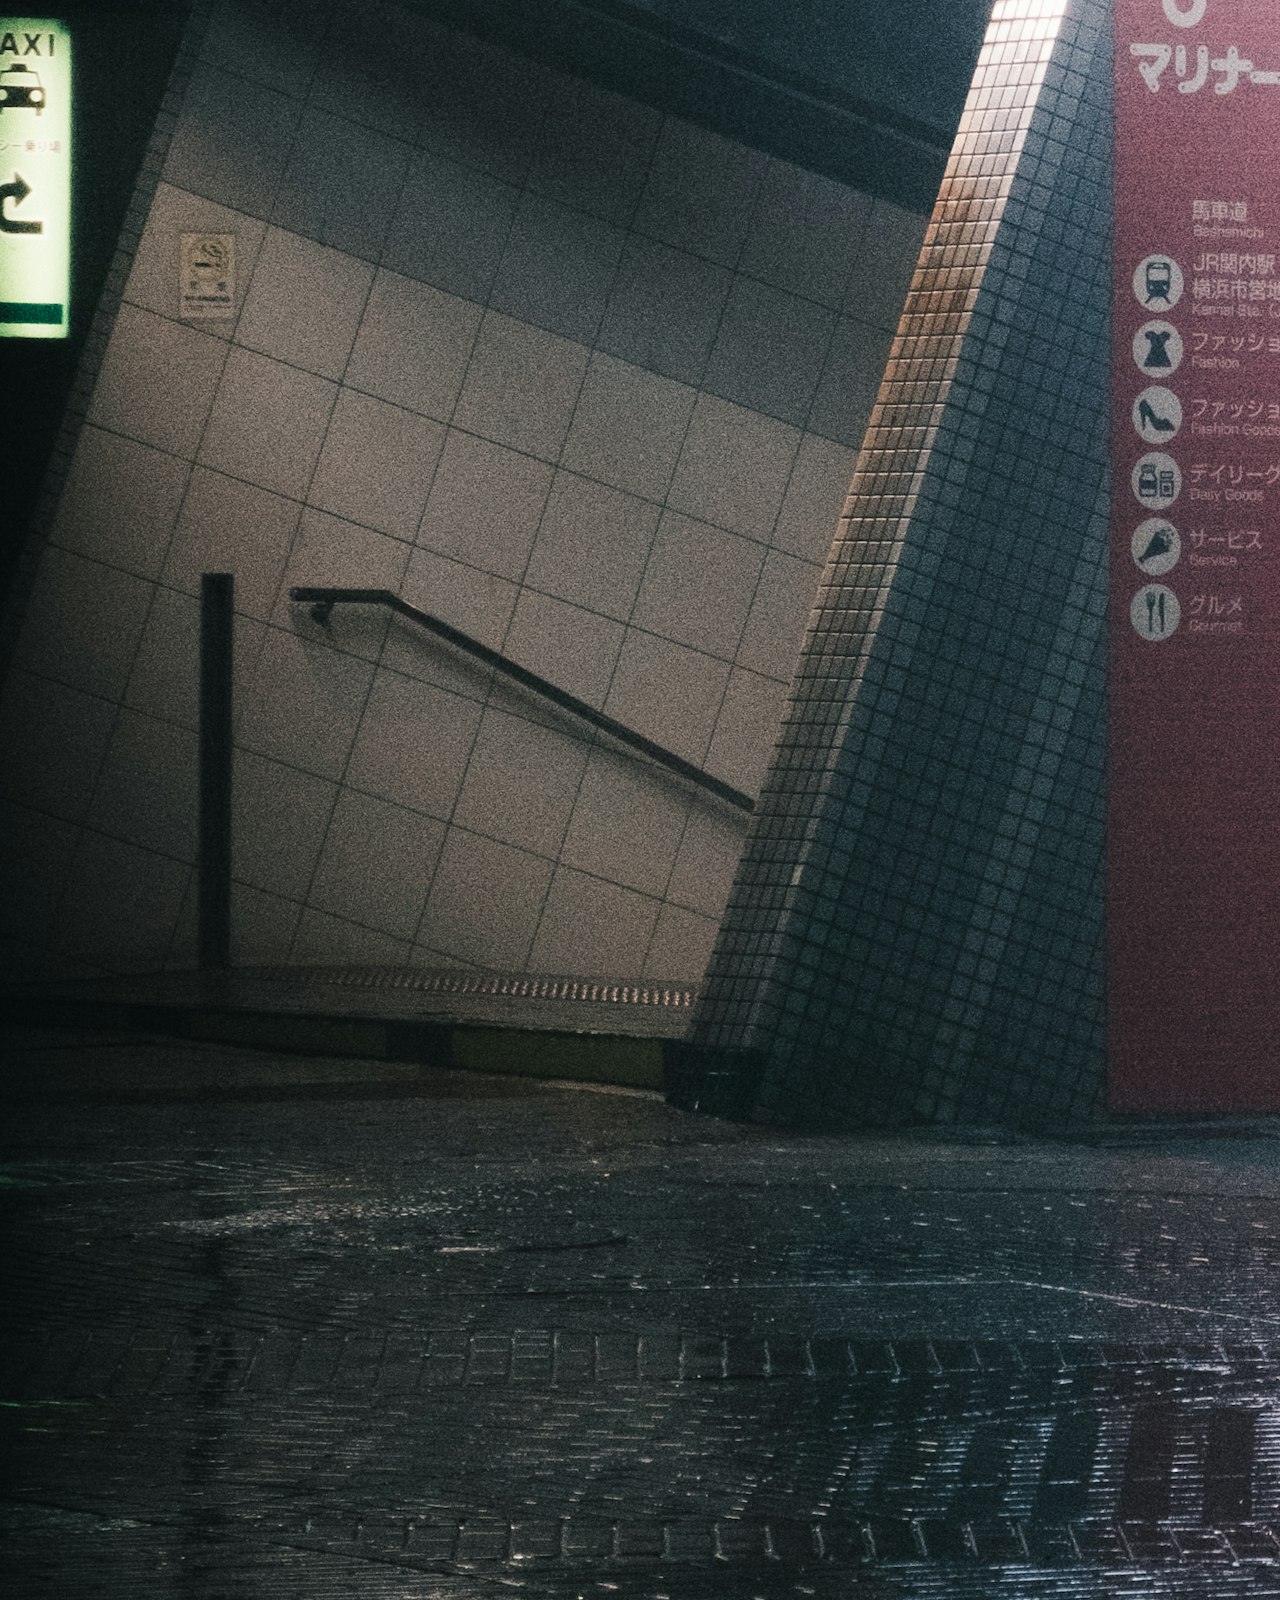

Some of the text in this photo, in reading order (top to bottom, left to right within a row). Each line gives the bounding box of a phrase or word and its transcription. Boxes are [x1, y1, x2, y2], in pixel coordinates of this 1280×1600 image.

[1192, 199, 1247, 222] 馬車道
[1193, 253, 1276, 275] JR関内駅
[1191, 355, 1240, 368] Fashion
[1189, 527, 1263, 550] サービス
[1189, 594, 1243, 615] グルメ
